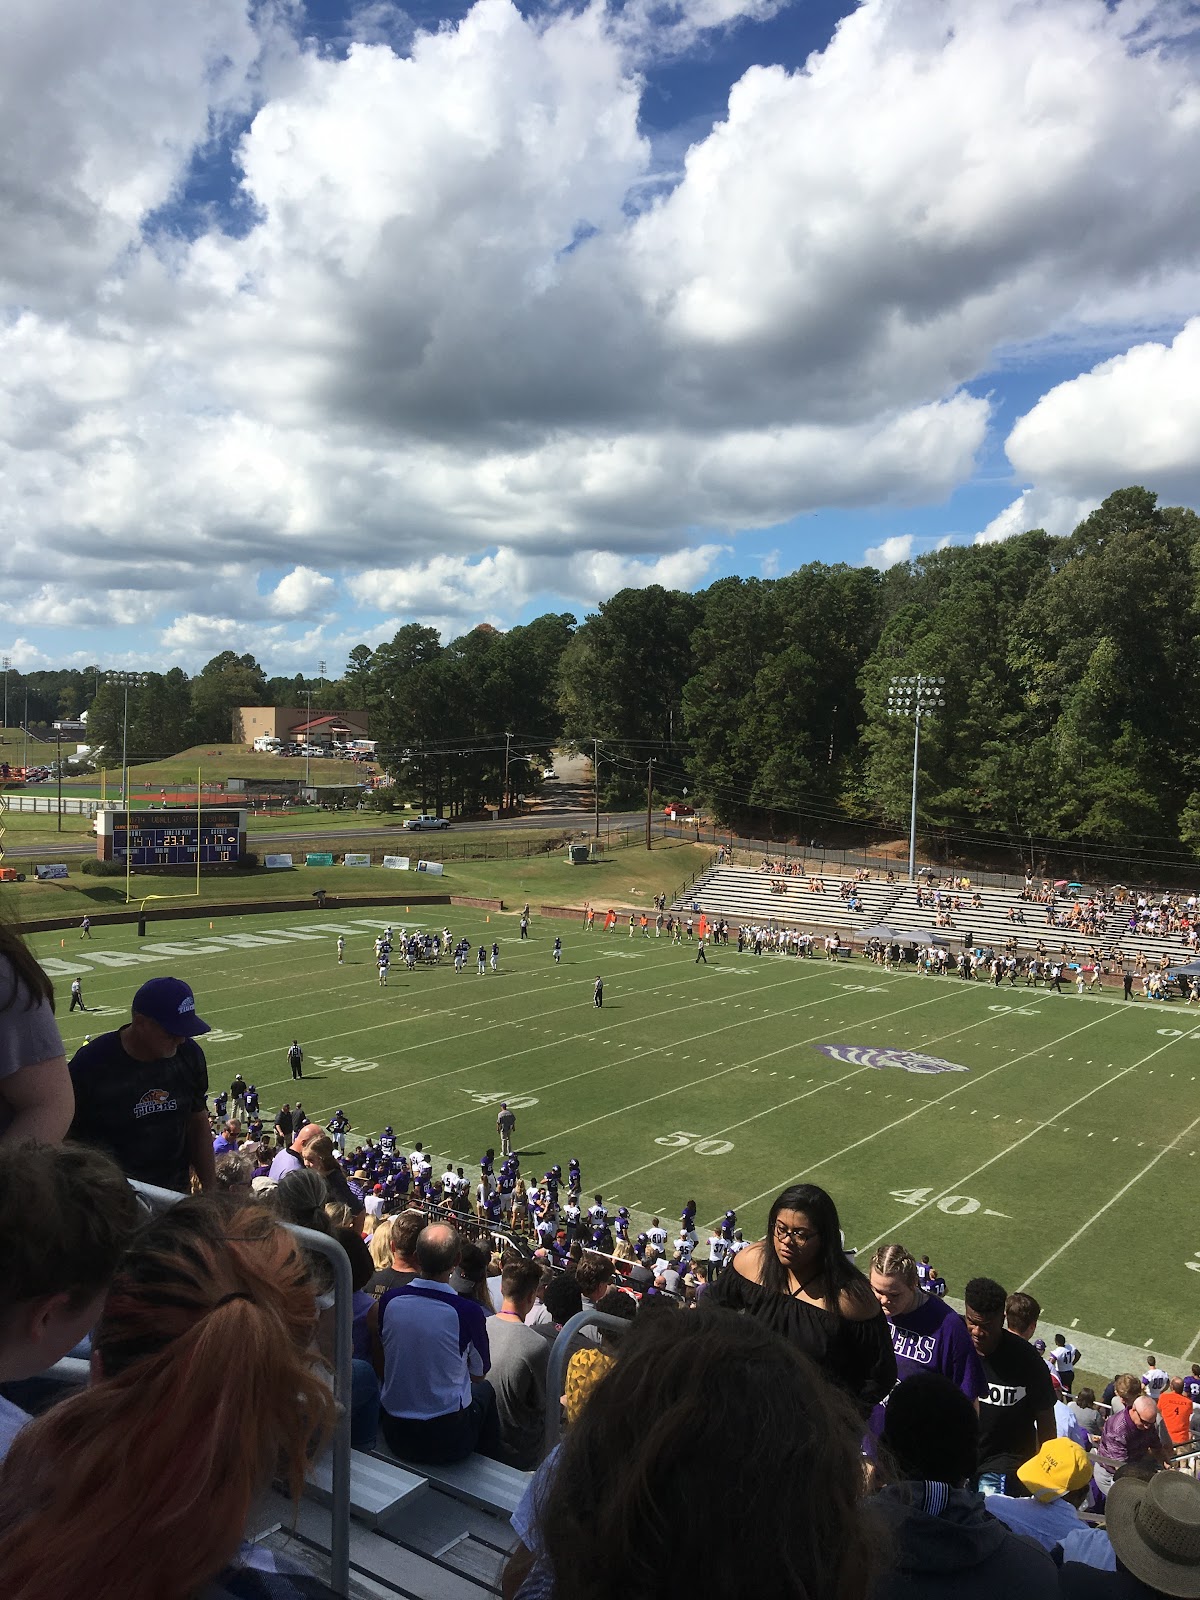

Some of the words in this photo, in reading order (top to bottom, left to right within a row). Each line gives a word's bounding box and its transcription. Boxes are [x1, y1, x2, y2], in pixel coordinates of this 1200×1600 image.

[35, 918, 427, 977] UACHITA
[313, 1055, 379, 1073] 30
[134, 1099, 177, 1118] TIGERS
[653, 1130, 736, 1155] 50
[888, 1187, 982, 1215] 40
[713, 1243, 724, 1253] 37
